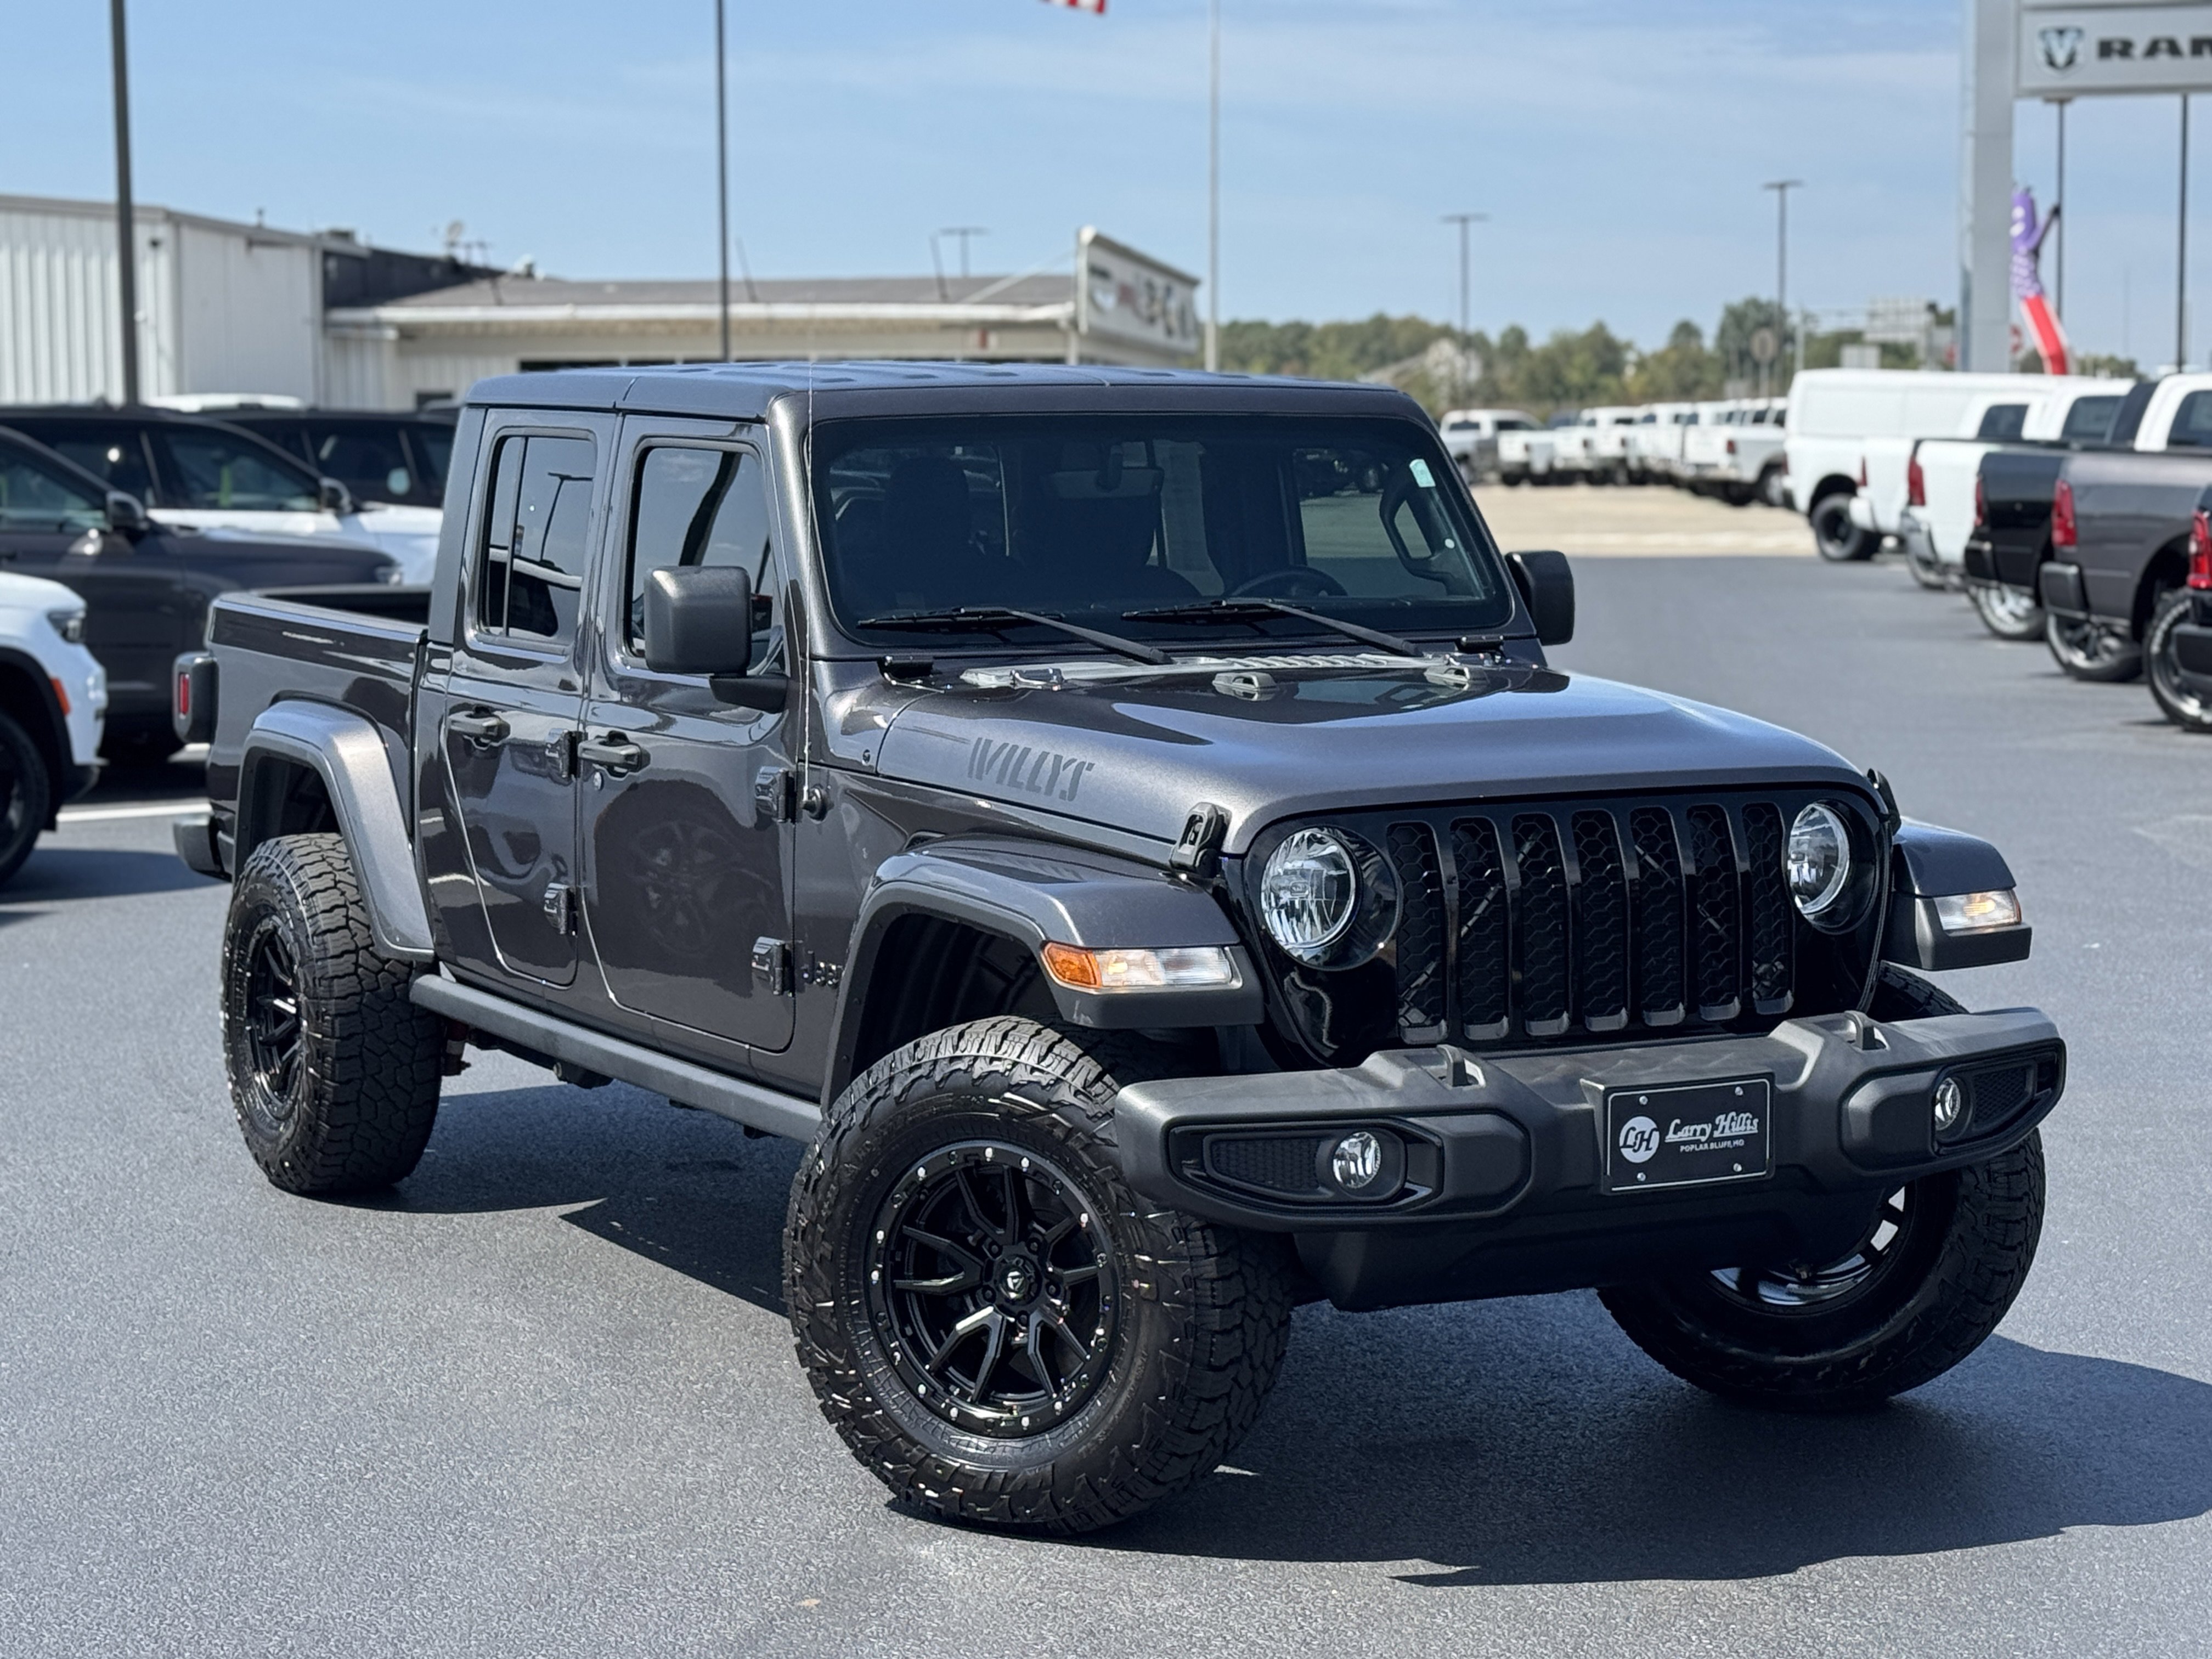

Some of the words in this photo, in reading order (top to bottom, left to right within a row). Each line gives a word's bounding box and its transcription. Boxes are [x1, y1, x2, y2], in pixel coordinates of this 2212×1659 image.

[967, 737, 1096, 802] WILLYS
[1664, 1119, 1712, 1143] Larry
[1713, 1111, 1759, 1138] Hillis
[1680, 1143, 1709, 1152] POPLAR
